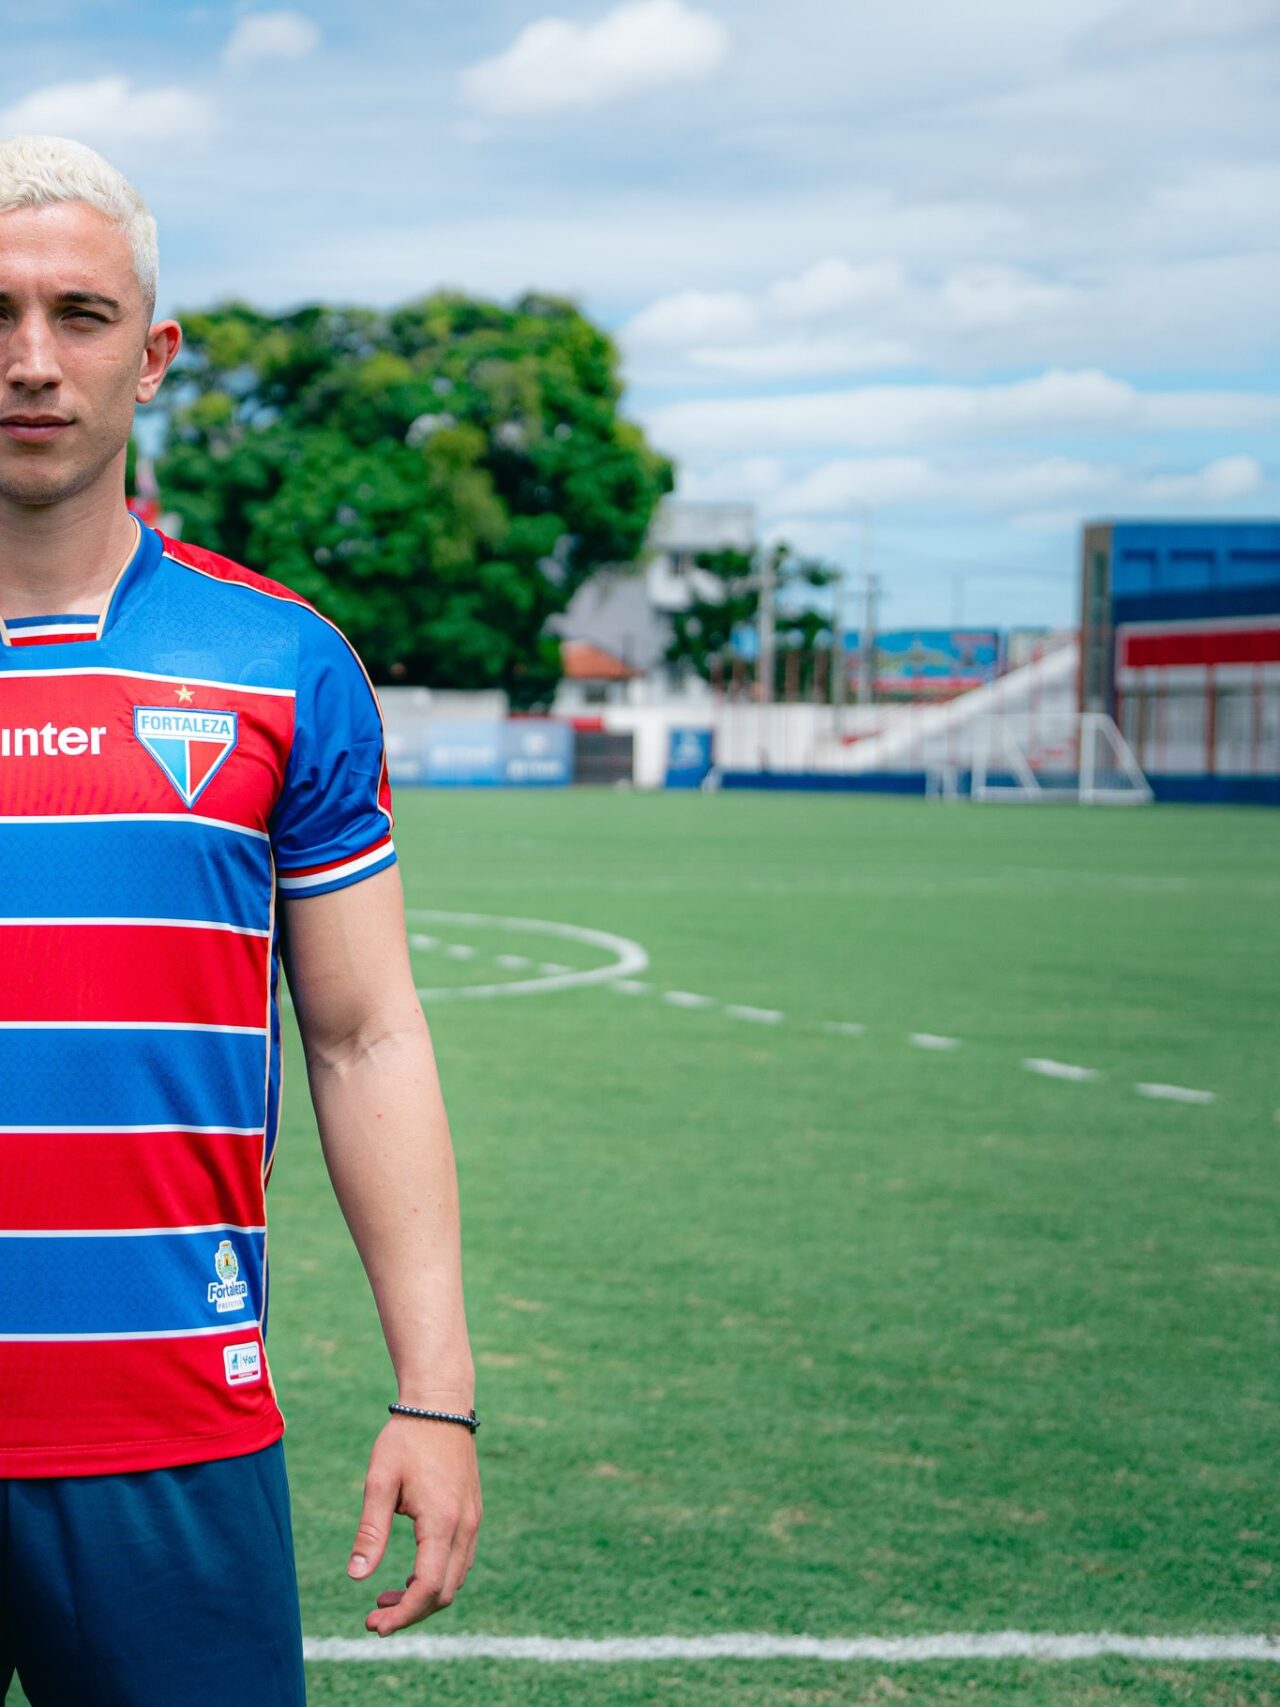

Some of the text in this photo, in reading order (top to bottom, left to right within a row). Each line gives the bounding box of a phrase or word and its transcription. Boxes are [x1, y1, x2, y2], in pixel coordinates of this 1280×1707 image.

[141, 715, 230, 735] FORTALEZA
[2, 722, 107, 756] inter
[210, 1281, 246, 1299] Fortaleza
